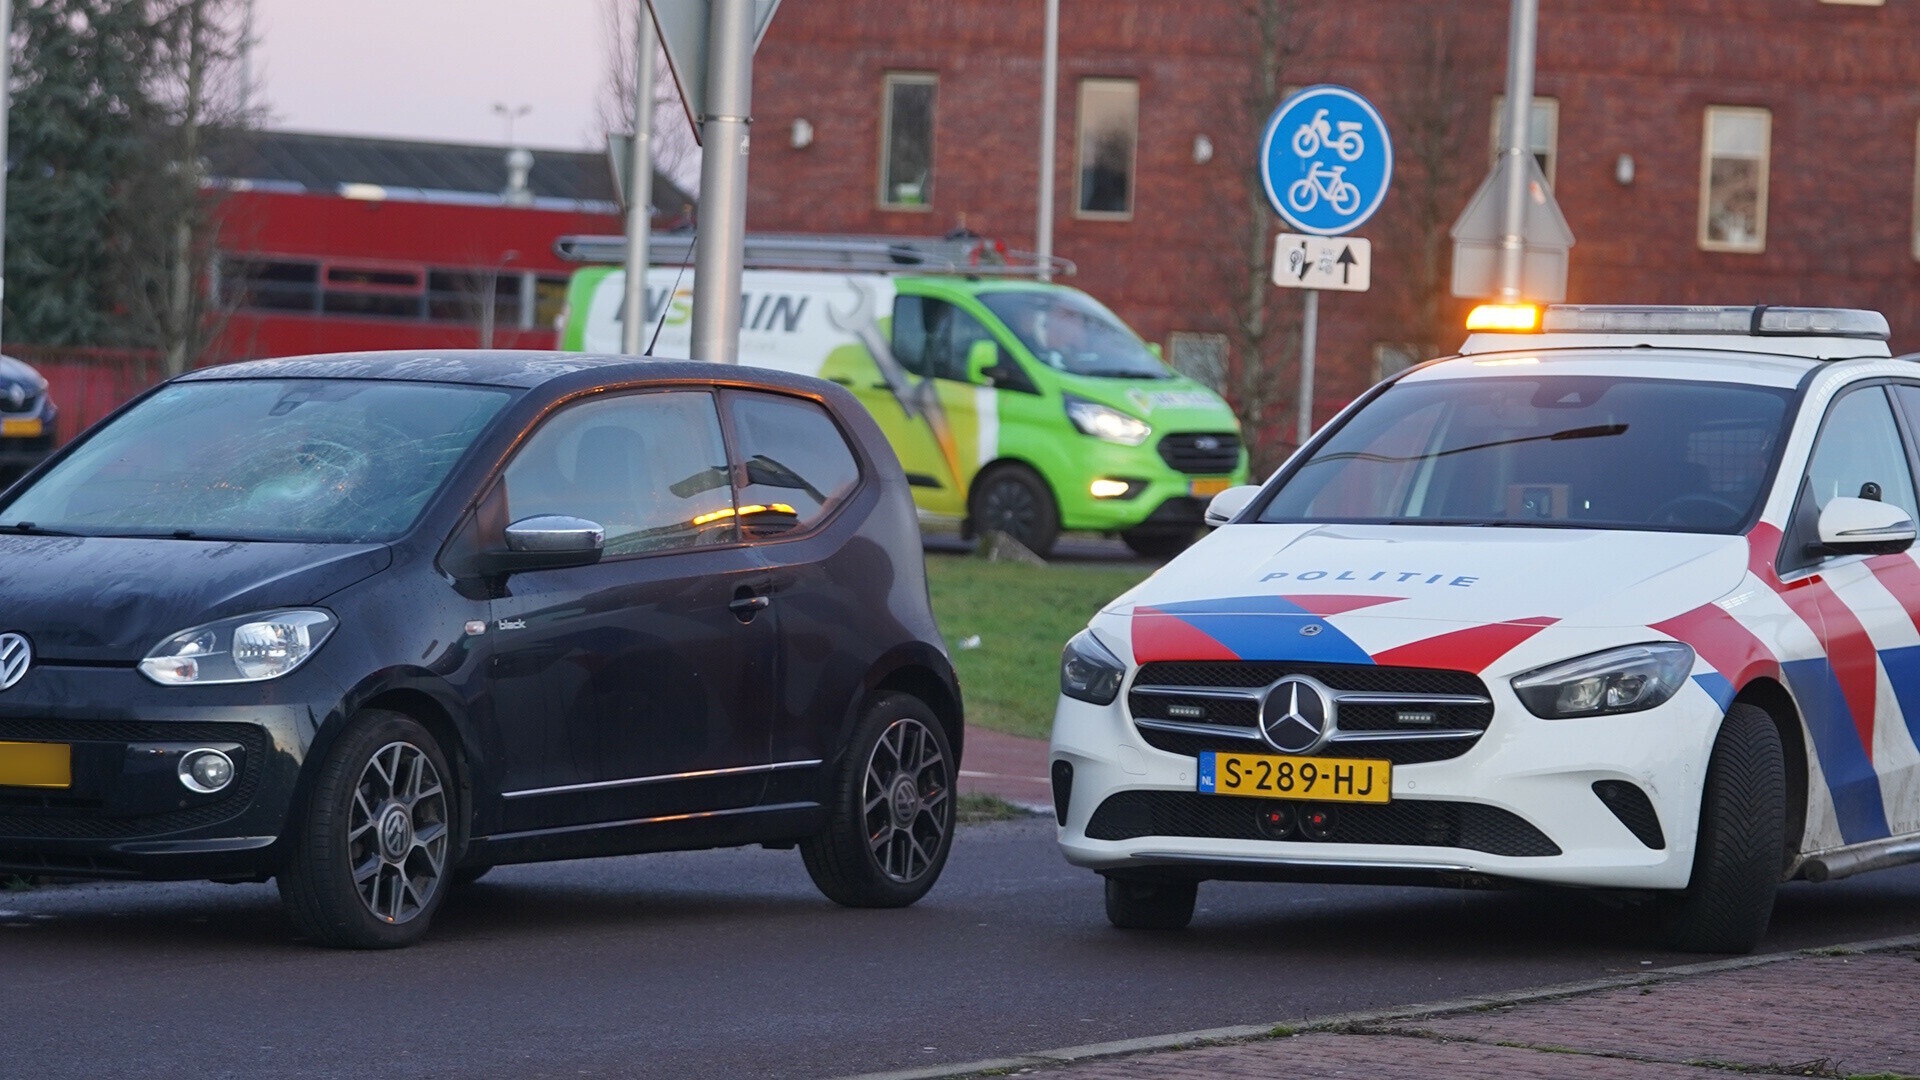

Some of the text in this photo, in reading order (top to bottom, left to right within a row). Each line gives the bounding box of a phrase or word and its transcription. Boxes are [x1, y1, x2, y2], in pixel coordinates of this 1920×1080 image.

[614, 287, 810, 331] NSIN
[1259, 570, 1479, 588] POLITIE
[499, 619, 526, 630] black
[1201, 775, 1214, 786] NL
[1225, 758, 1373, 796] S-289-HJ
